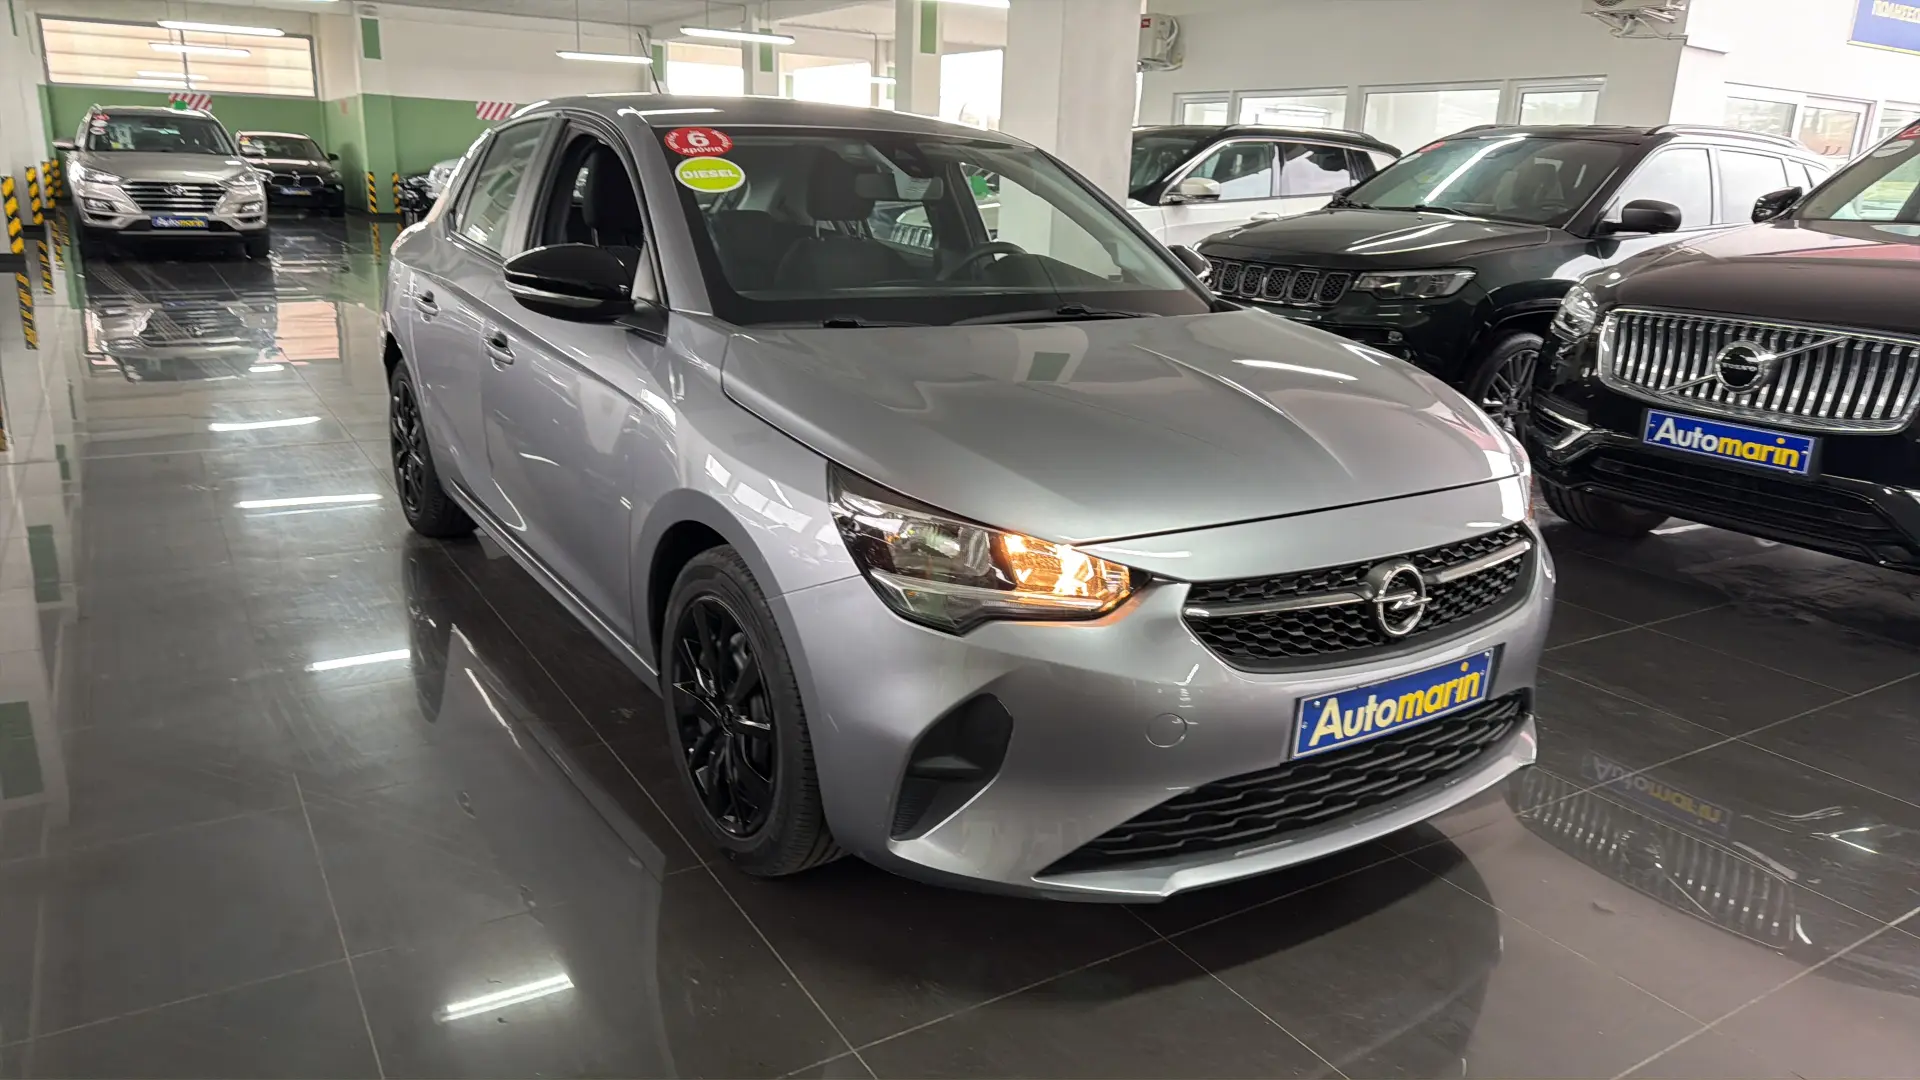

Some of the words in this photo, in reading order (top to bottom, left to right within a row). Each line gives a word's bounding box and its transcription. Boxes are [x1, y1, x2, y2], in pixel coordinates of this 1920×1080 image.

[686, 131, 711, 148] 6
[682, 168, 740, 179] DIESEL
[1653, 417, 1800, 468] Automarin
[1308, 661, 1481, 747] Automarin
